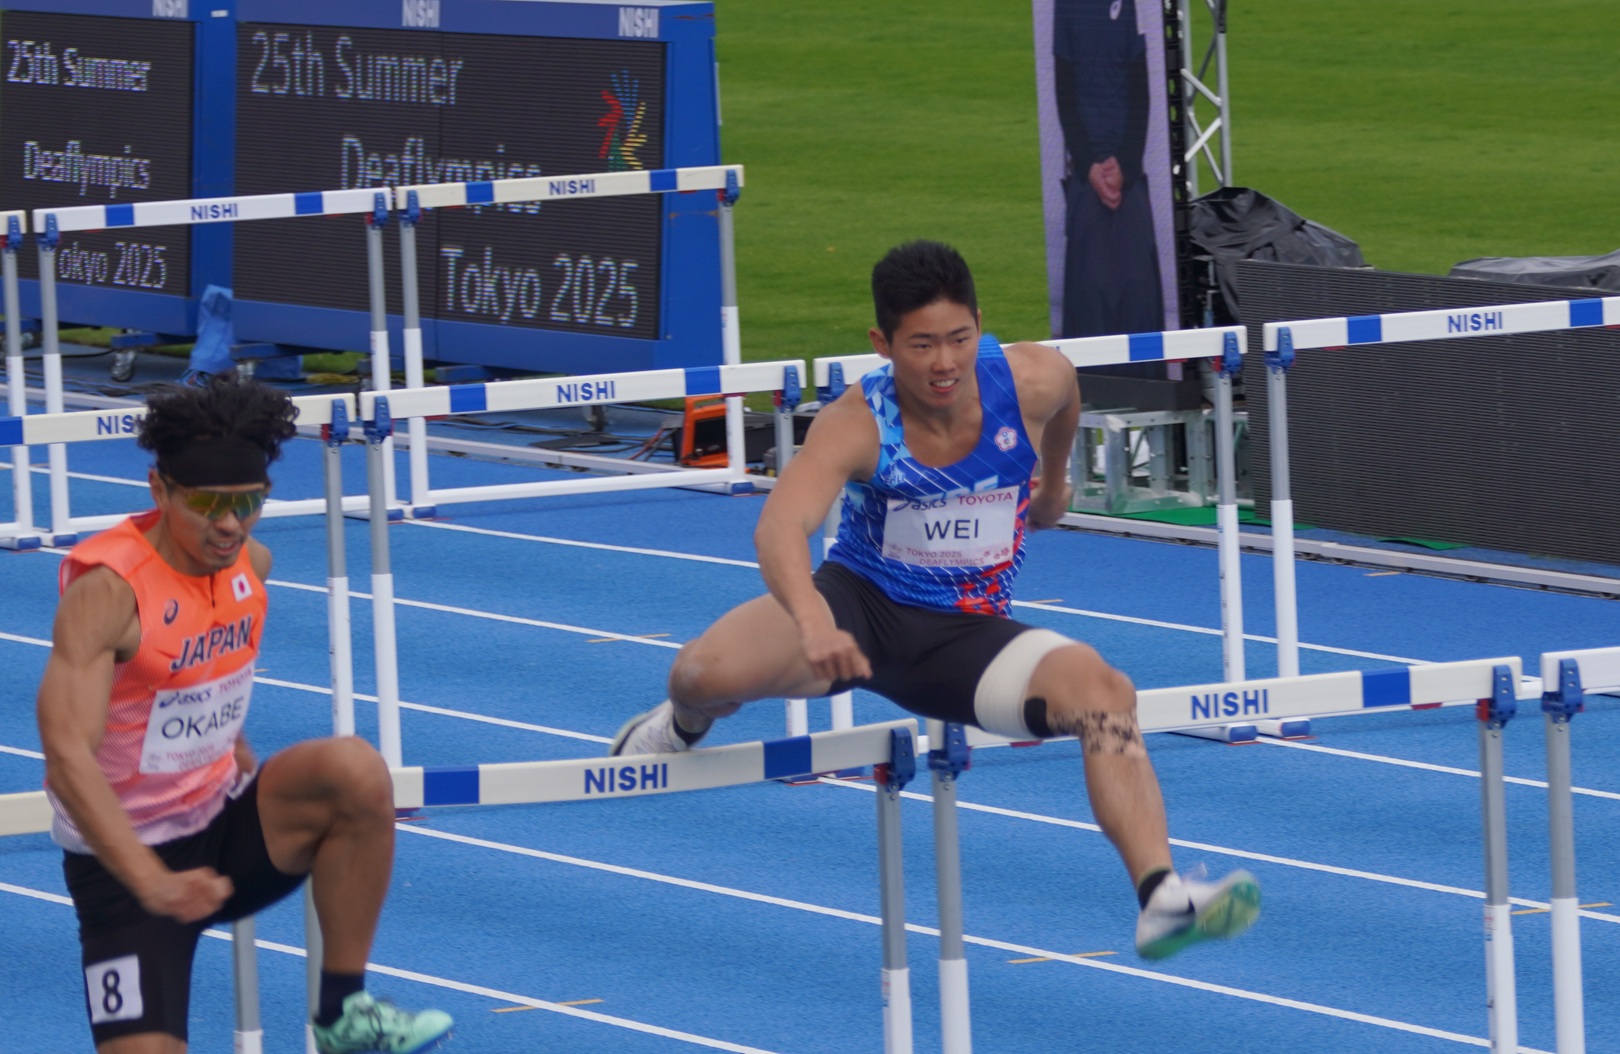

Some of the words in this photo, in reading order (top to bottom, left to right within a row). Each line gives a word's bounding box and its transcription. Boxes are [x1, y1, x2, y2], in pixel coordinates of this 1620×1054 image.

[402, 0, 440, 27] NISHI
[618, 8, 659, 38] NISHI
[6, 39, 59, 85] 25th
[62, 47, 152, 92] Summer
[251, 31, 324, 97] 25th
[335, 36, 464, 105] Summer
[23, 140, 151, 199] Deaflympics
[549, 178, 596, 195] NISHI
[190, 203, 238, 220] NISHI
[52, 241, 108, 285] okyo
[113, 241, 167, 289] 2025
[440, 246, 542, 324] Tokyo
[550, 253, 639, 328] 2025
[1447, 311, 1504, 333] NISHI
[557, 380, 616, 403] NISHI
[957, 492, 1013, 506] TOYOTA
[924, 518, 980, 541] WEI
[906, 548, 937, 559] TOKYO
[940, 551, 962, 559] 2025
[170, 615, 252, 673] JAPAN
[161, 696, 244, 740] OKABE
[1190, 689, 1269, 720] NISHI
[583, 763, 669, 795] NISHI
[102, 969, 123, 1014] 8
